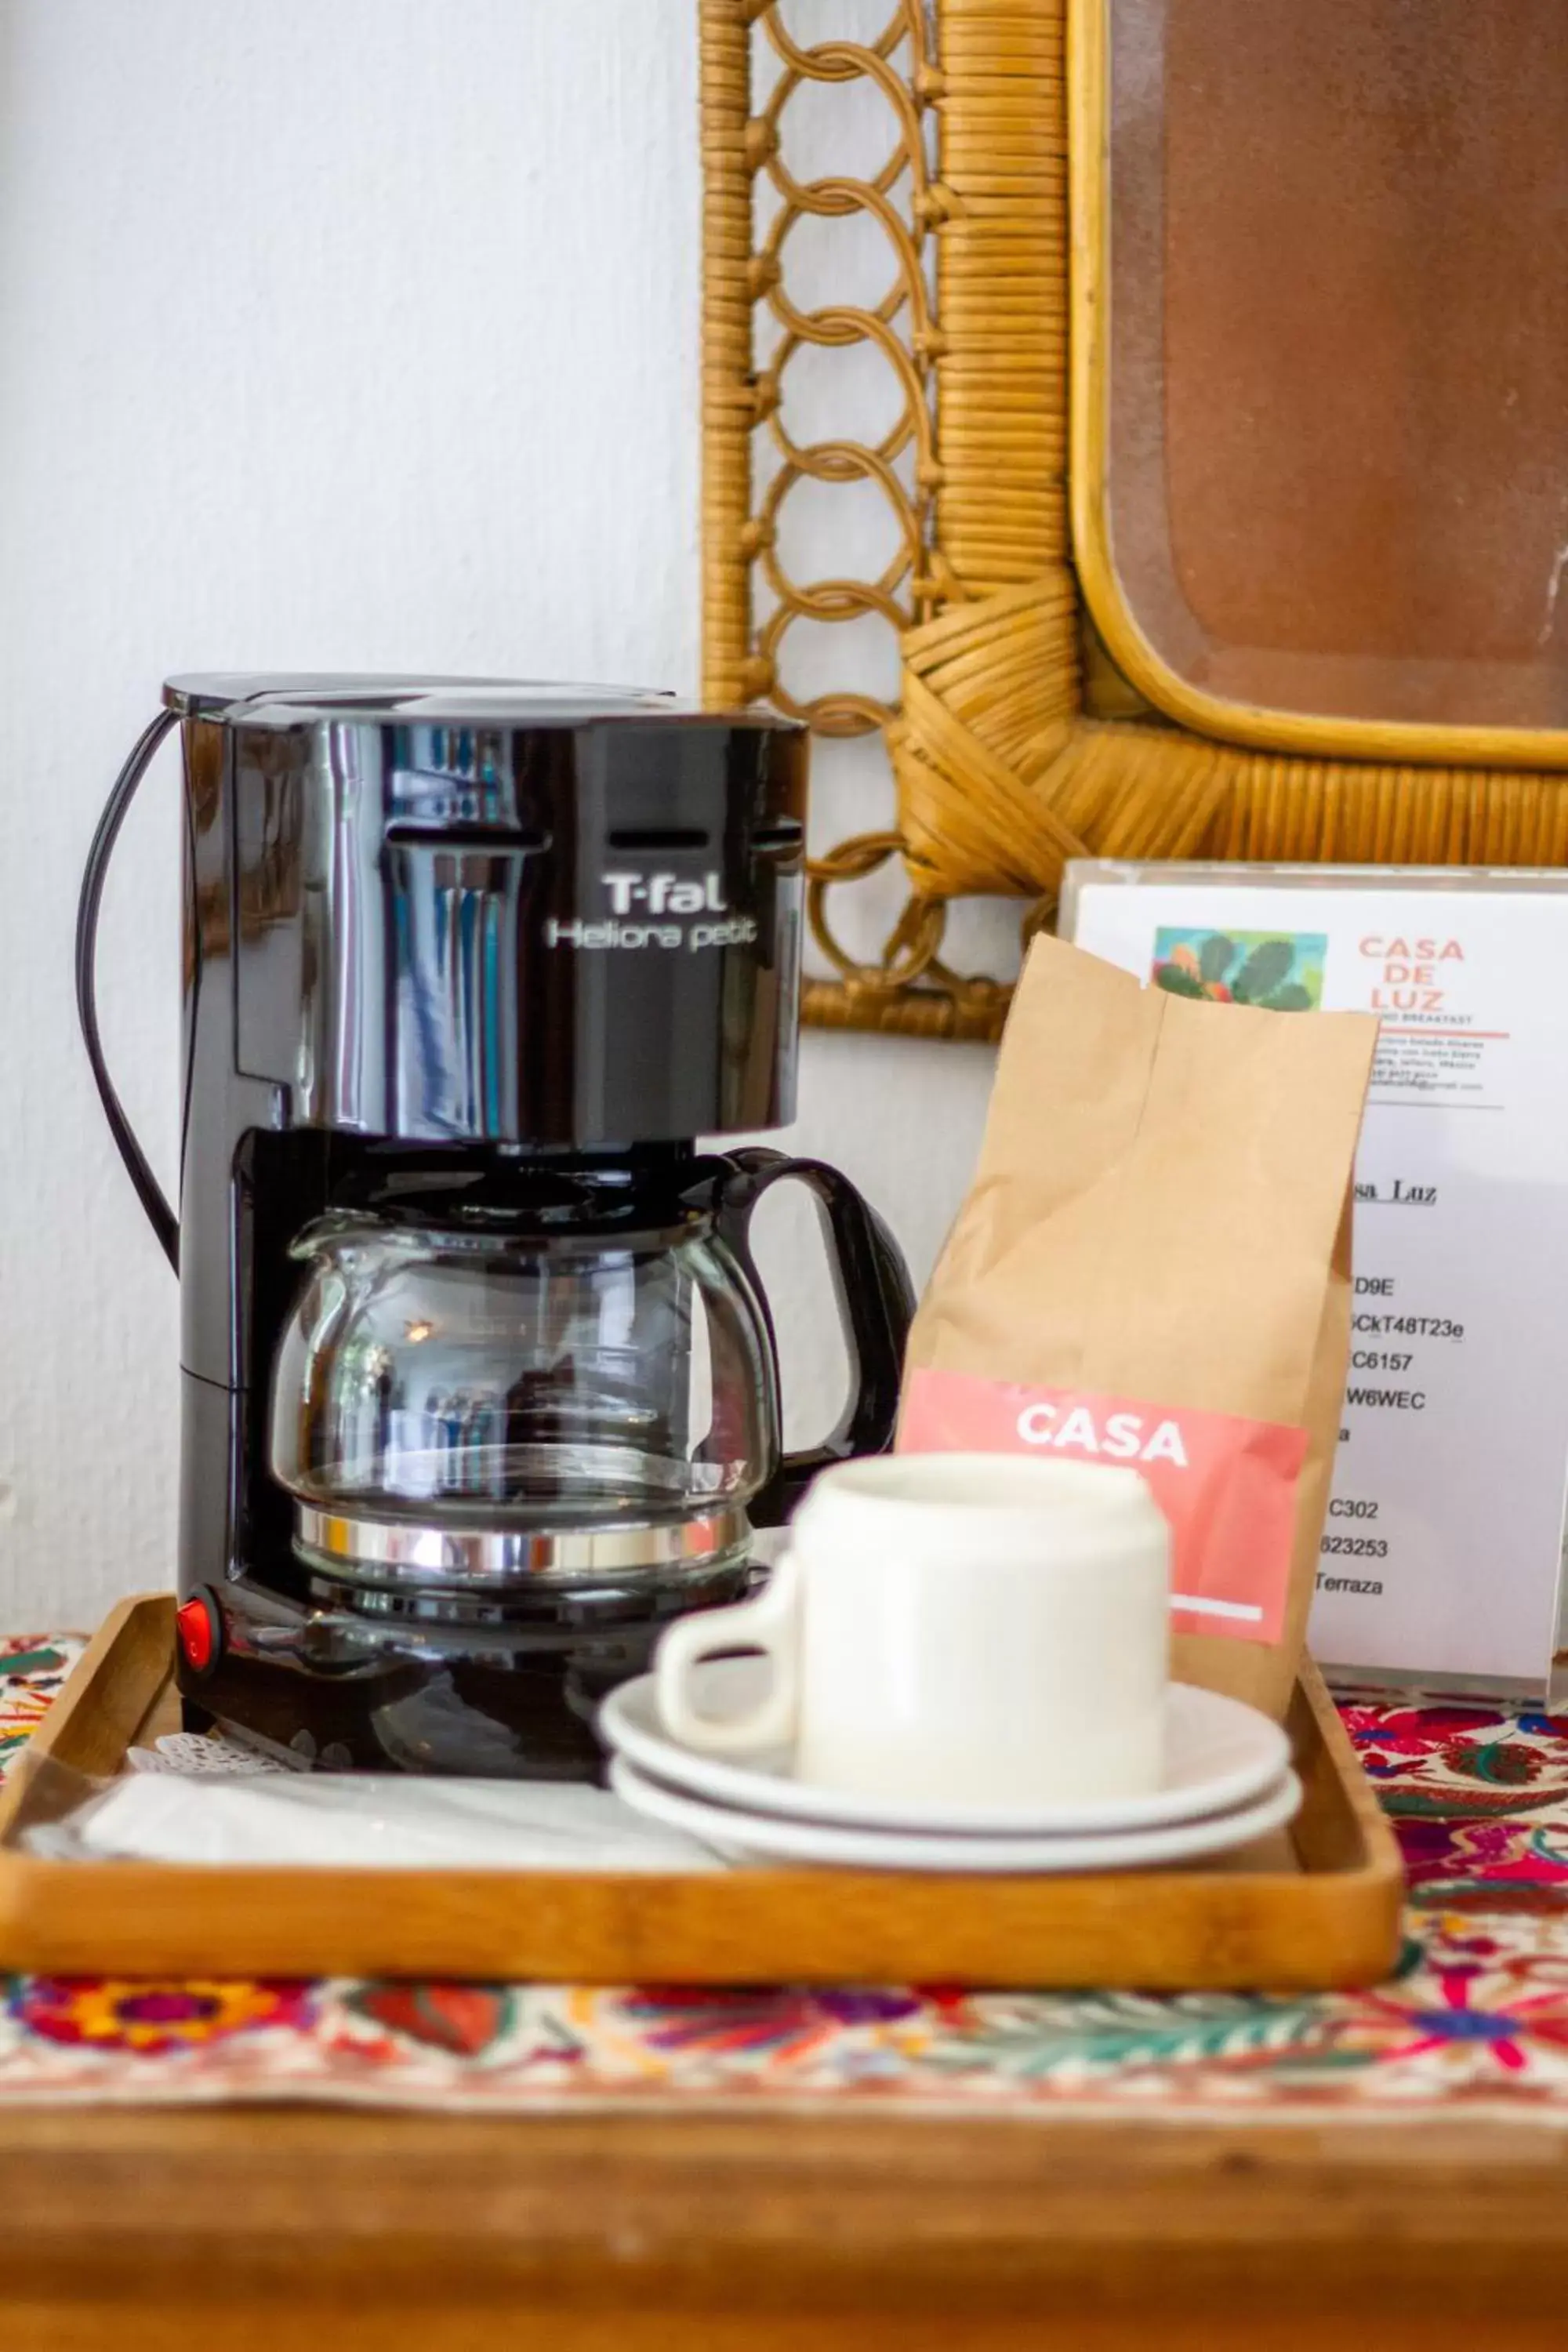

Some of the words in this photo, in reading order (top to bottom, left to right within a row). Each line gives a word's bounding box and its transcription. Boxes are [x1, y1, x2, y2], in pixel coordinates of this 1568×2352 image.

[548, 918, 682, 949] Heliora
[1359, 936, 1465, 961] CASA
[1385, 964, 1435, 985] DE
[1371, 988, 1444, 1012] LUZ
[1392, 1179, 1437, 1205] Luz
[1348, 1350, 1414, 1371] C6157
[1016, 1402, 1189, 1468] CASA
[1329, 1498, 1379, 1519] C302
[1316, 1571, 1384, 1595] Terraza
